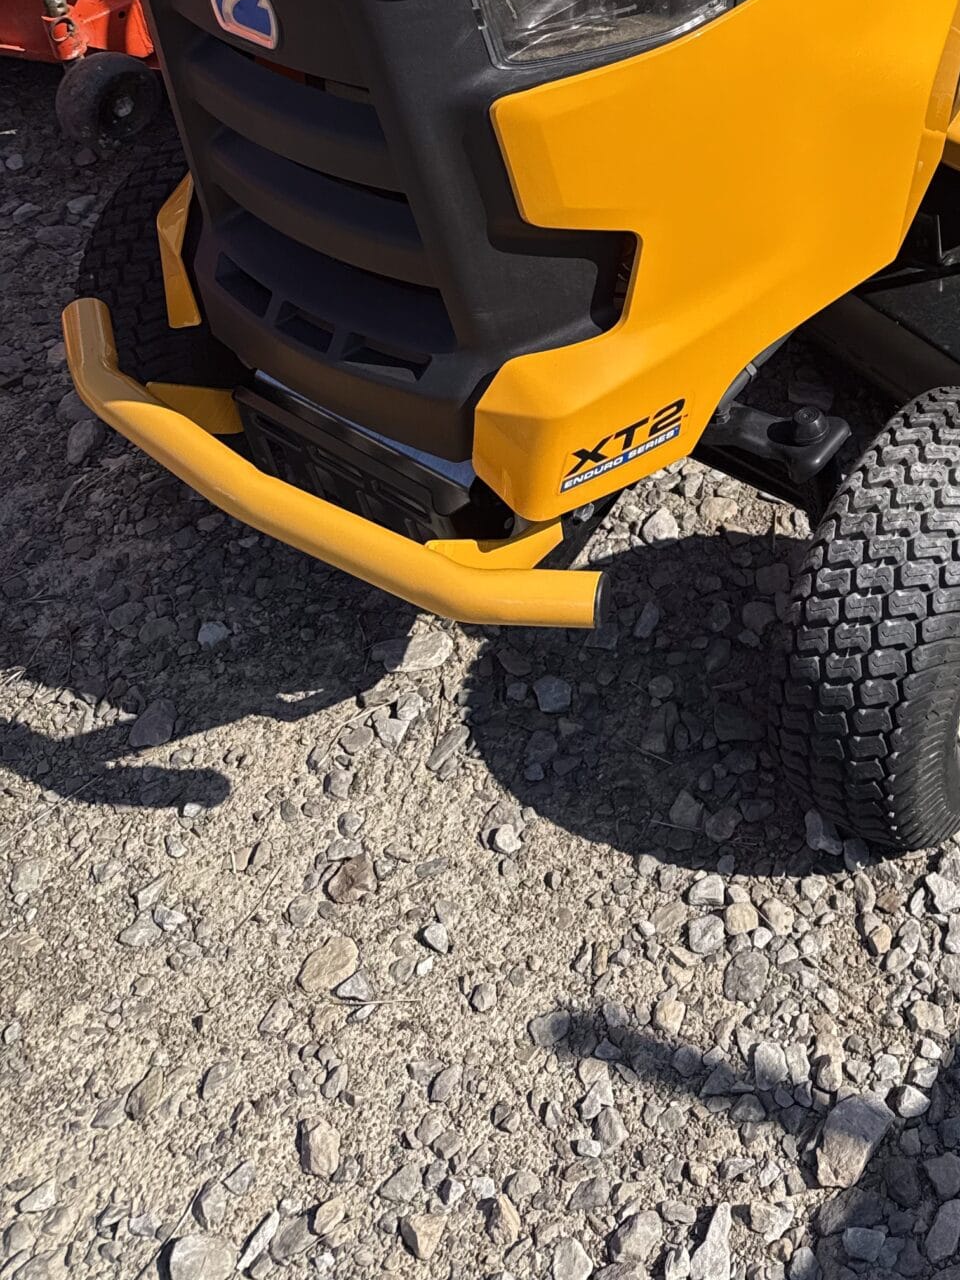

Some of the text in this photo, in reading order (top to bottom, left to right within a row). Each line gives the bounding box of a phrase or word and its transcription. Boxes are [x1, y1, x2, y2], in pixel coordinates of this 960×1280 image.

[563, 426, 677, 489] ENDURO SERIES
[564, 398, 685, 478] XT2
